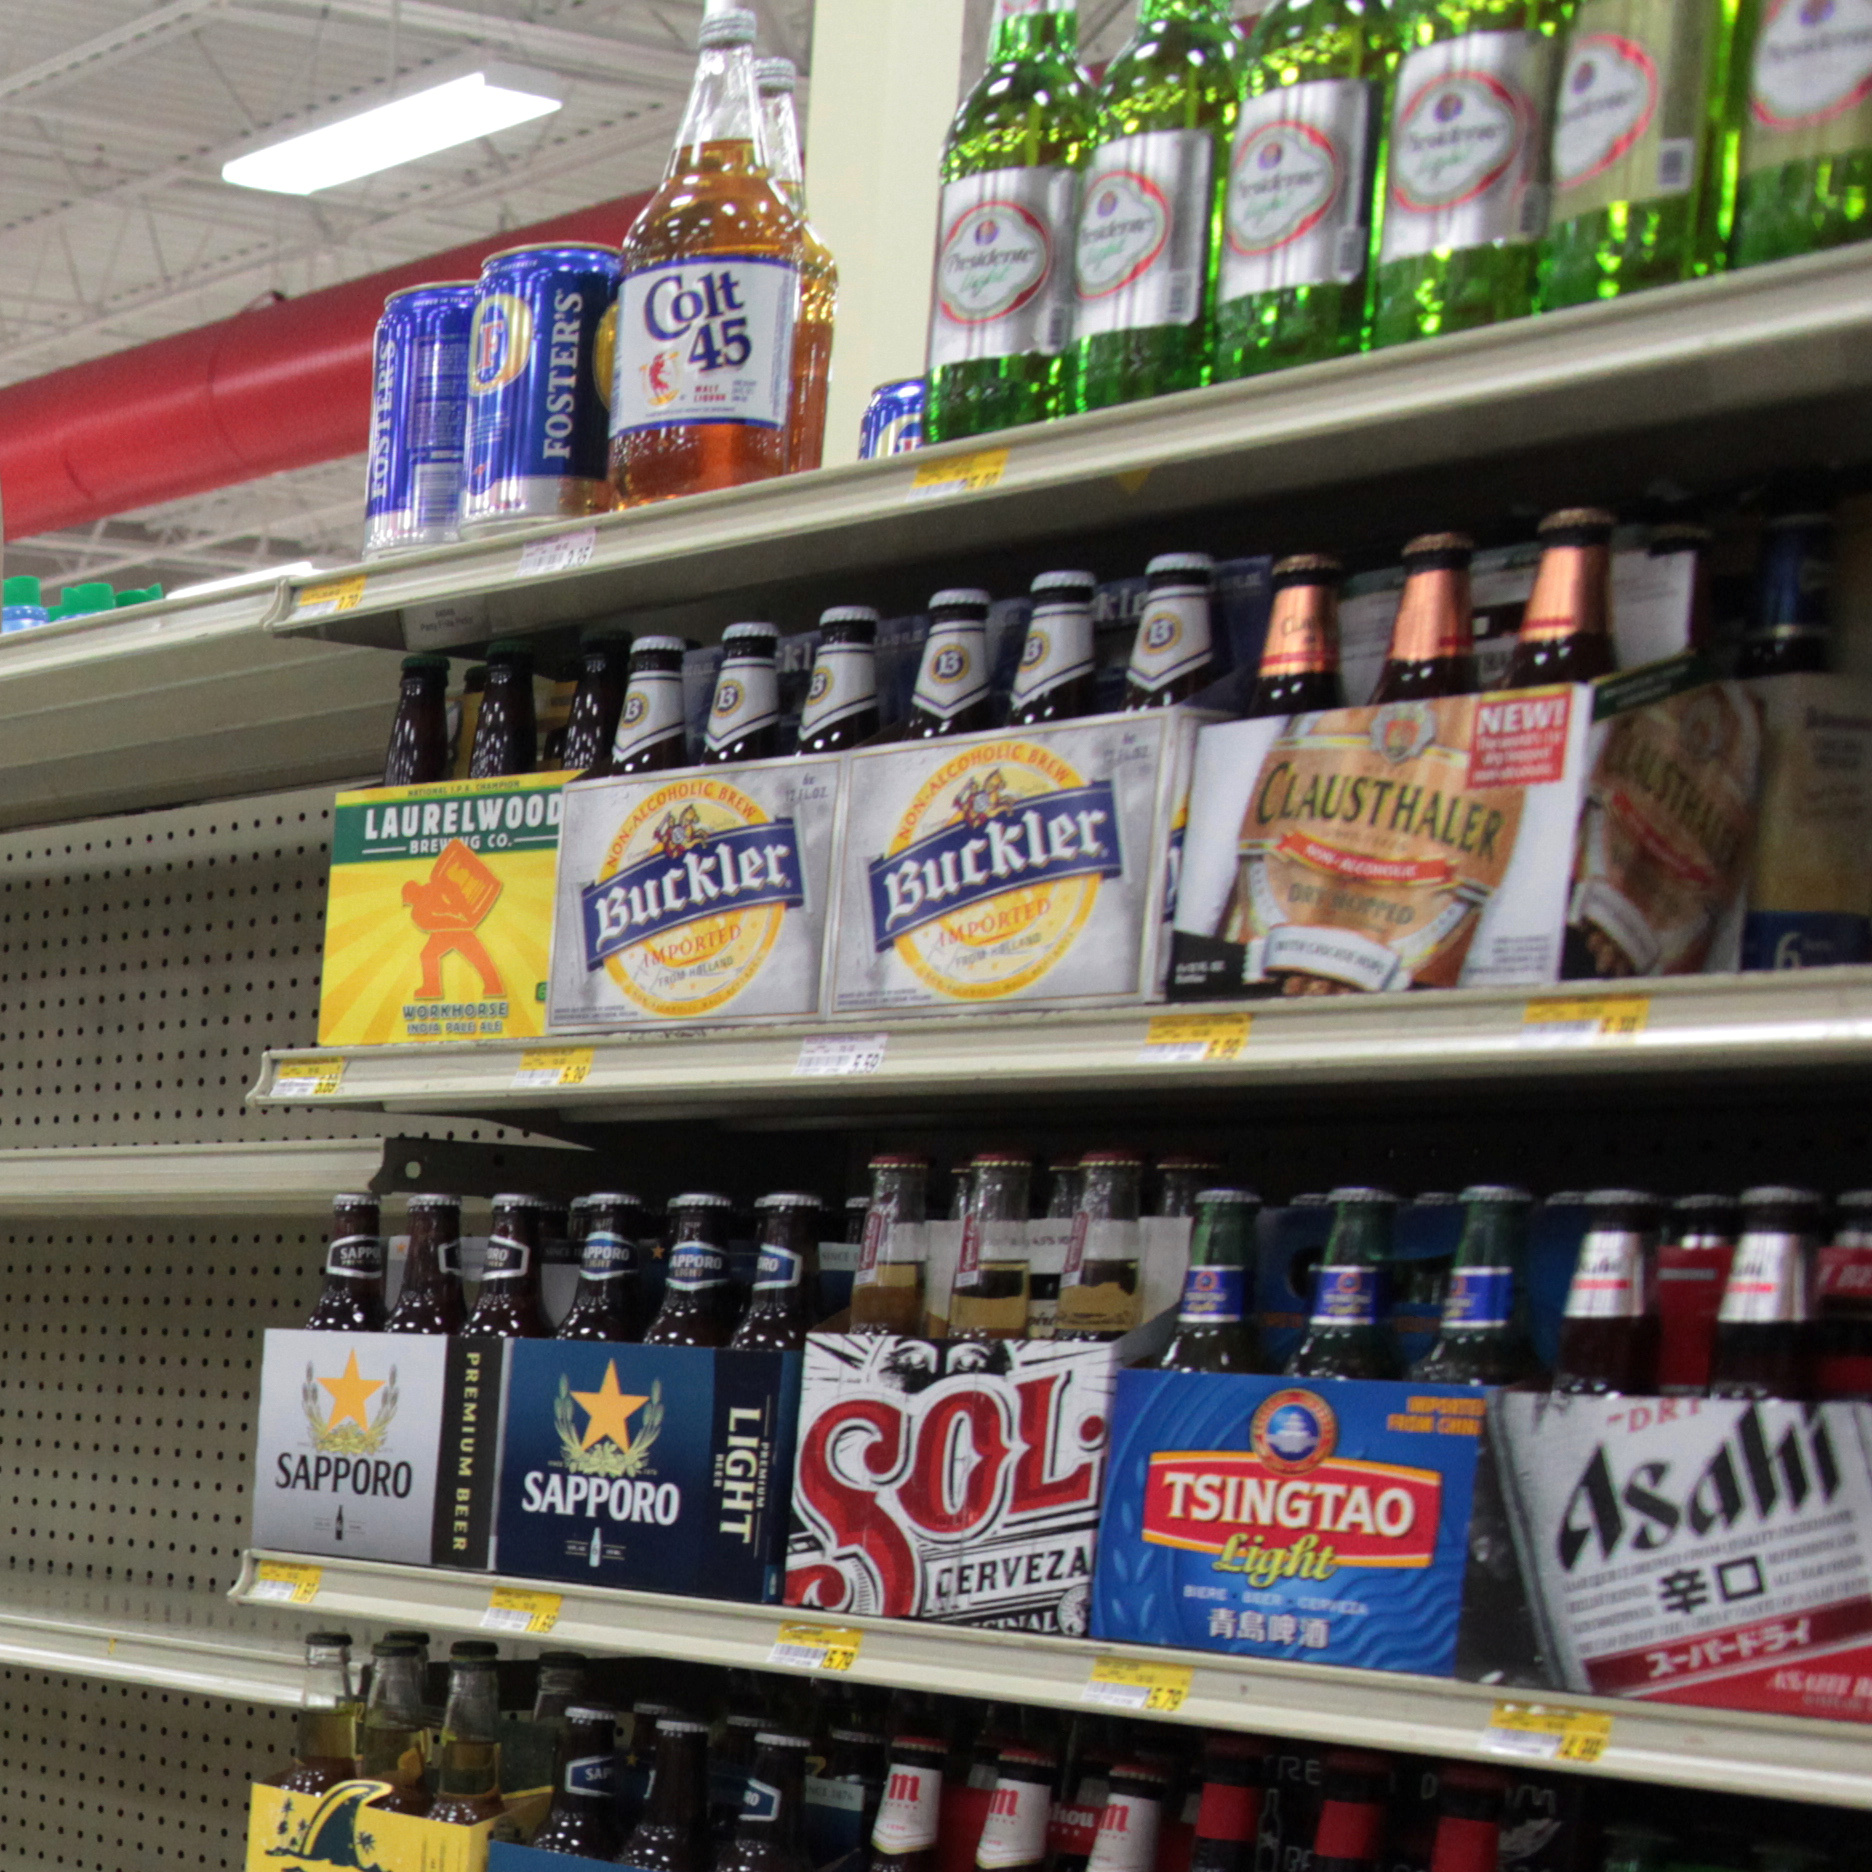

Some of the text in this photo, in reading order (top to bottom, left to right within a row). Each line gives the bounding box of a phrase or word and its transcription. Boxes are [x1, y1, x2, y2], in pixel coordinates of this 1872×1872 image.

[643, 270, 745, 342] Colt
[687, 316, 753, 373] 45
[542, 290, 584, 461] FOSTER'S
[372, 338, 397, 499] FOSTER'S
[1477, 697, 1566, 735] NEW!
[364, 792, 564, 841] LAURELWOOD
[897, 743, 1071, 840] NON-ALCOHOLIC BREW
[1258, 761, 1503, 862] CLAUSTHALER
[487, 834, 513, 849] CO.
[606, 782, 757, 868] NON-ALCOHOLIC BREW
[594, 843, 790, 953] Buckler
[882, 808, 1107, 932] Buckler
[643, 923, 742, 968] IMPORTED
[938, 897, 1052, 947] IMPORTED
[656, 954, 735, 988] FROM HOLLAND
[402, 1001, 509, 1020] WORKHORSE
[407, 1020, 503, 1035] INDIA PALE ALE
[275, 1450, 414, 1501] SAPPORO
[452, 1351, 481, 1551] PREMIUM BEER
[719, 1405, 761, 1544] LIGHT
[757, 1441, 770, 1509] PREMIUM
[520, 1468, 682, 1527] SAPPORO
[784, 1368, 1106, 1617] SOL
[1162, 1470, 1416, 1538] TSINGTAO
[1556, 1402, 1842, 1574] Asahi
[934, 1545, 1088, 1599] CERVEZA
[1211, 1531, 1337, 1589] Light
[1656, 1556, 1766, 1616] 辛口
[1206, 1607, 1330, 1650] 青島啤酒
